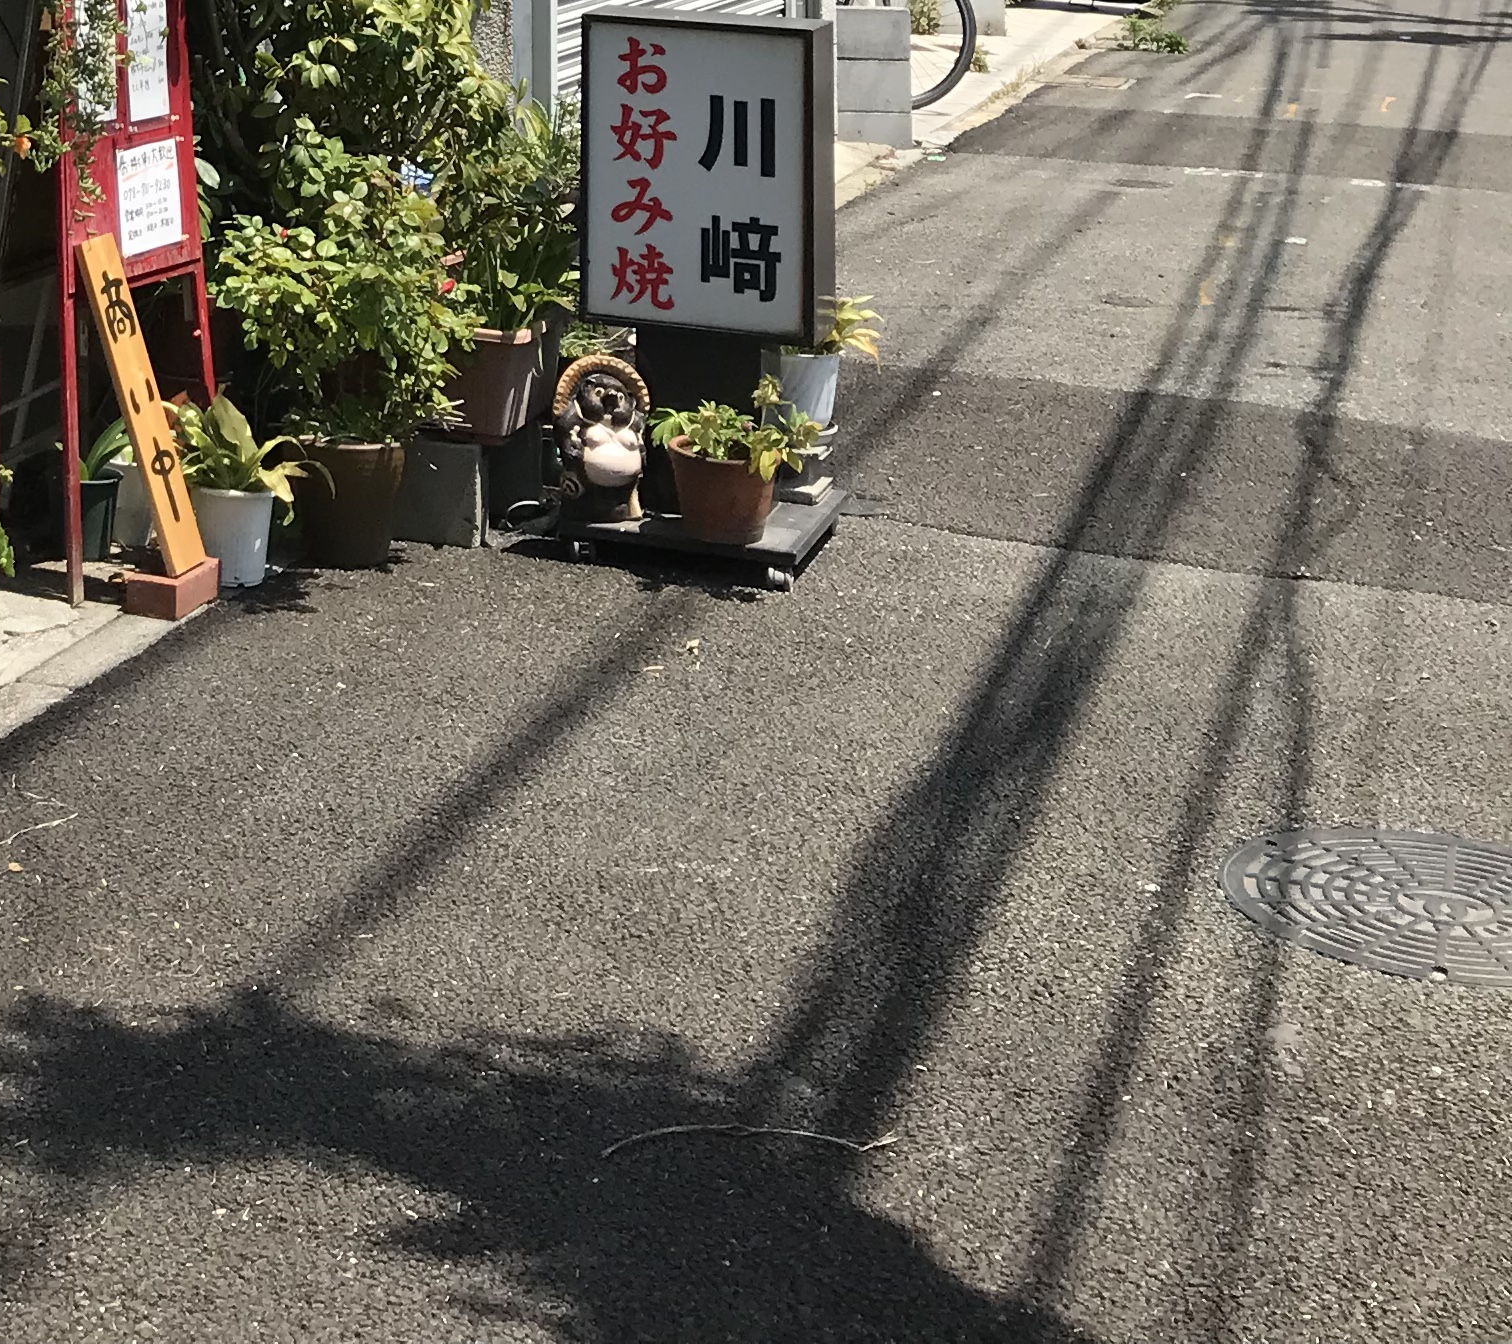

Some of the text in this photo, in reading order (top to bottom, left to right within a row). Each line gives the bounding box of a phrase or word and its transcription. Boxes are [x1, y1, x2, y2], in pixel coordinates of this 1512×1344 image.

[610, 36, 678, 310] お好み焼
[101, 270, 180, 522] 商い中
